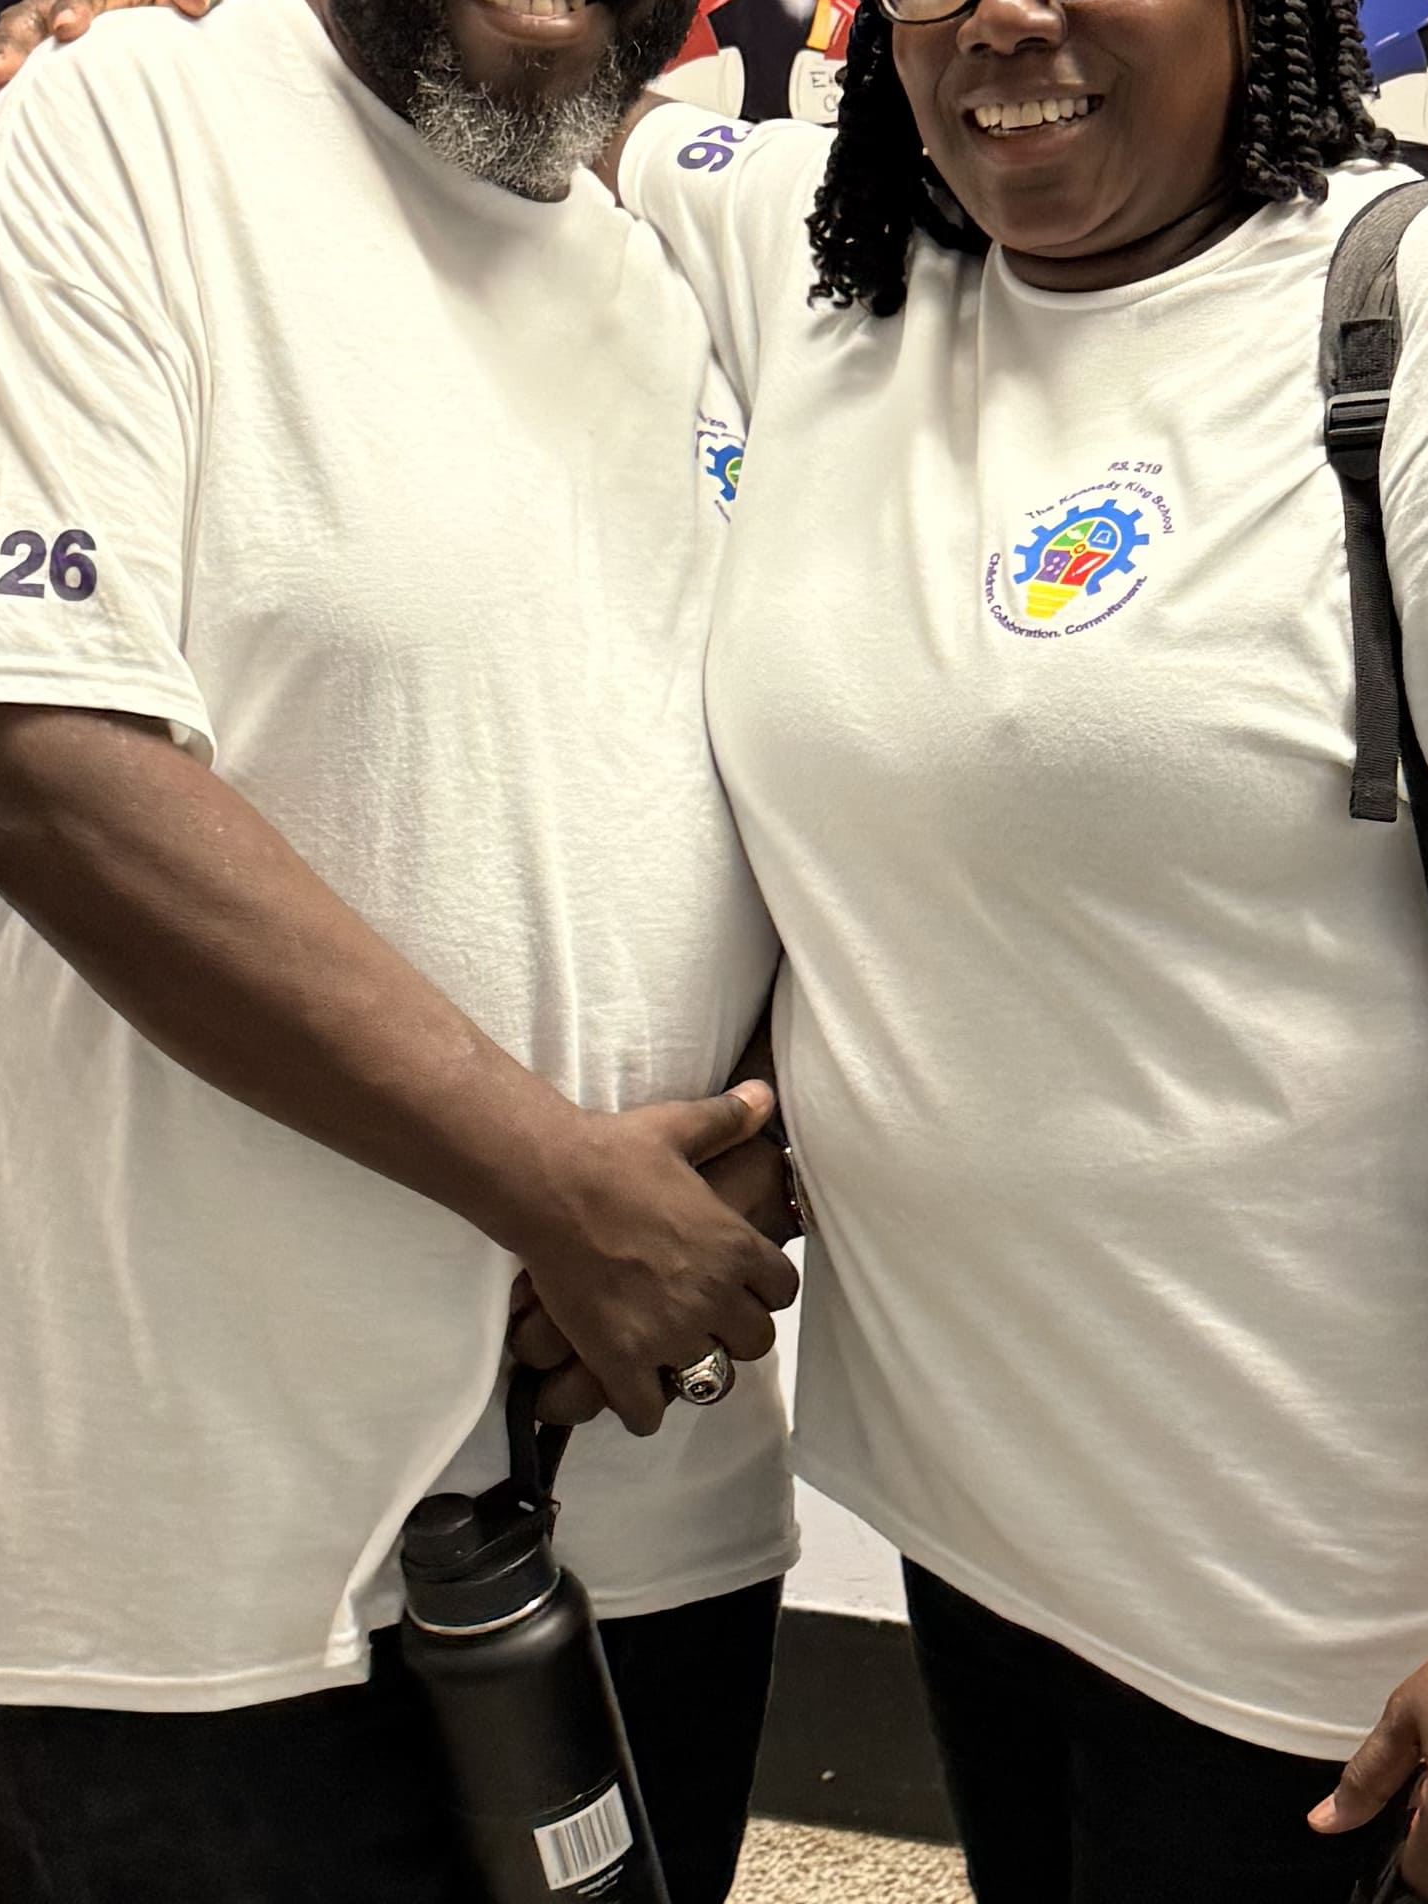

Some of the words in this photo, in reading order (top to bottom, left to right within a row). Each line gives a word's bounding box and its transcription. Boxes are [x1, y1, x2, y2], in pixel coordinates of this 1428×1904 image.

[1133, 461, 1163, 475] 219
[1124, 480, 1153, 499] King
[1152, 495, 1175, 534] School
